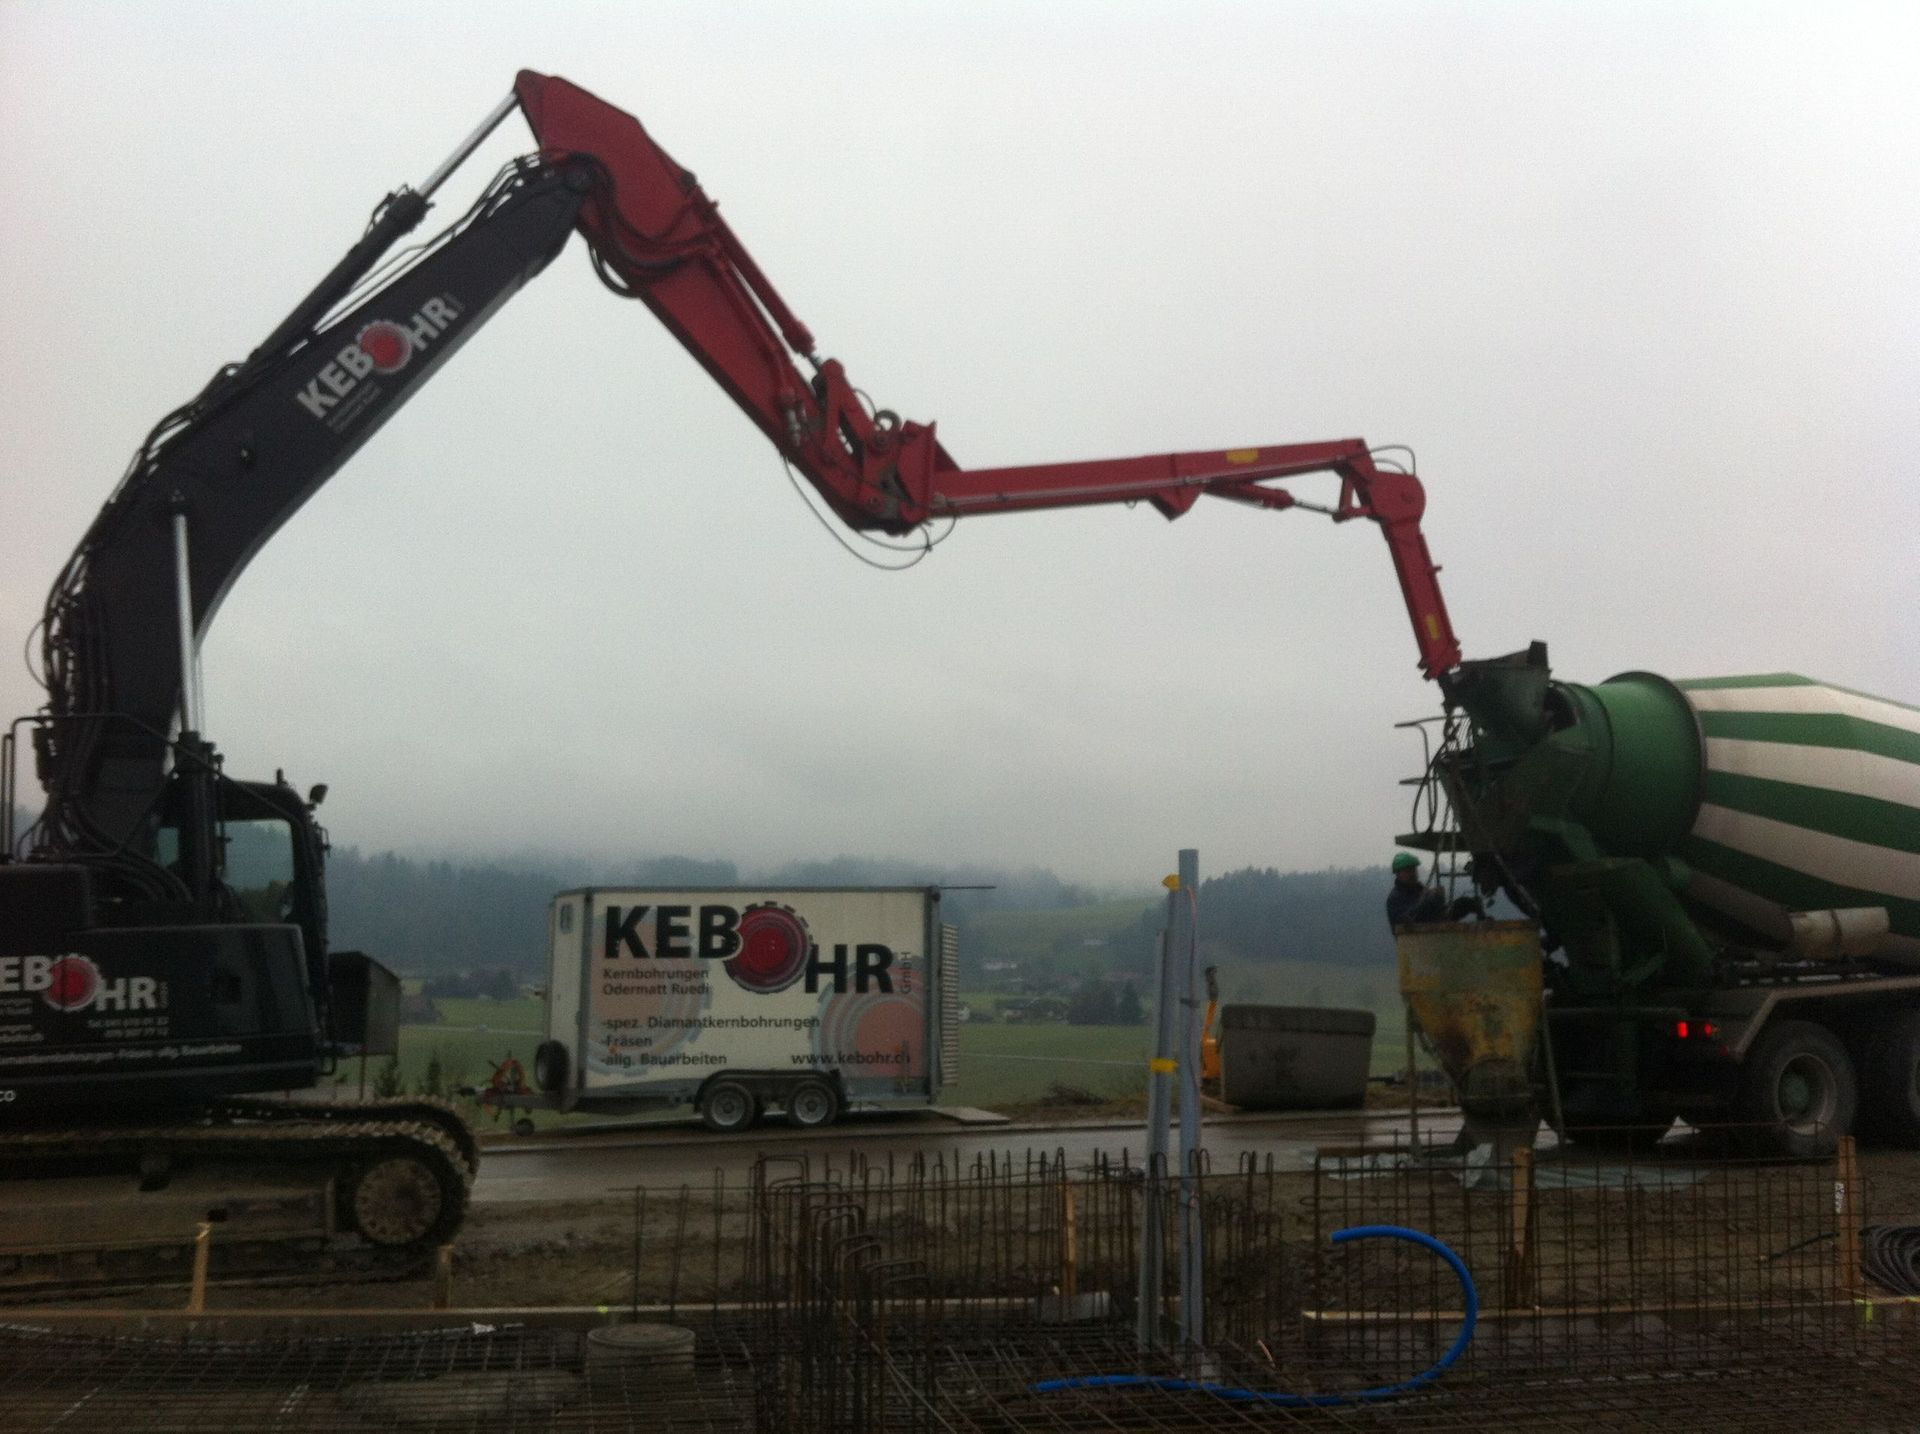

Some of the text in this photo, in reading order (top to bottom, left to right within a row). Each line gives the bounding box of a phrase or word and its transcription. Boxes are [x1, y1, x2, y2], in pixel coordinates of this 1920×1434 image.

[602, 967, 709, 981] Kernbohrungen
[602, 983, 710, 995] Odermatt Ruedi
[647, 1015, 820, 1031] Diamantkernbohrungen
[640, 1052, 728, 1066] Bauarbeiten
